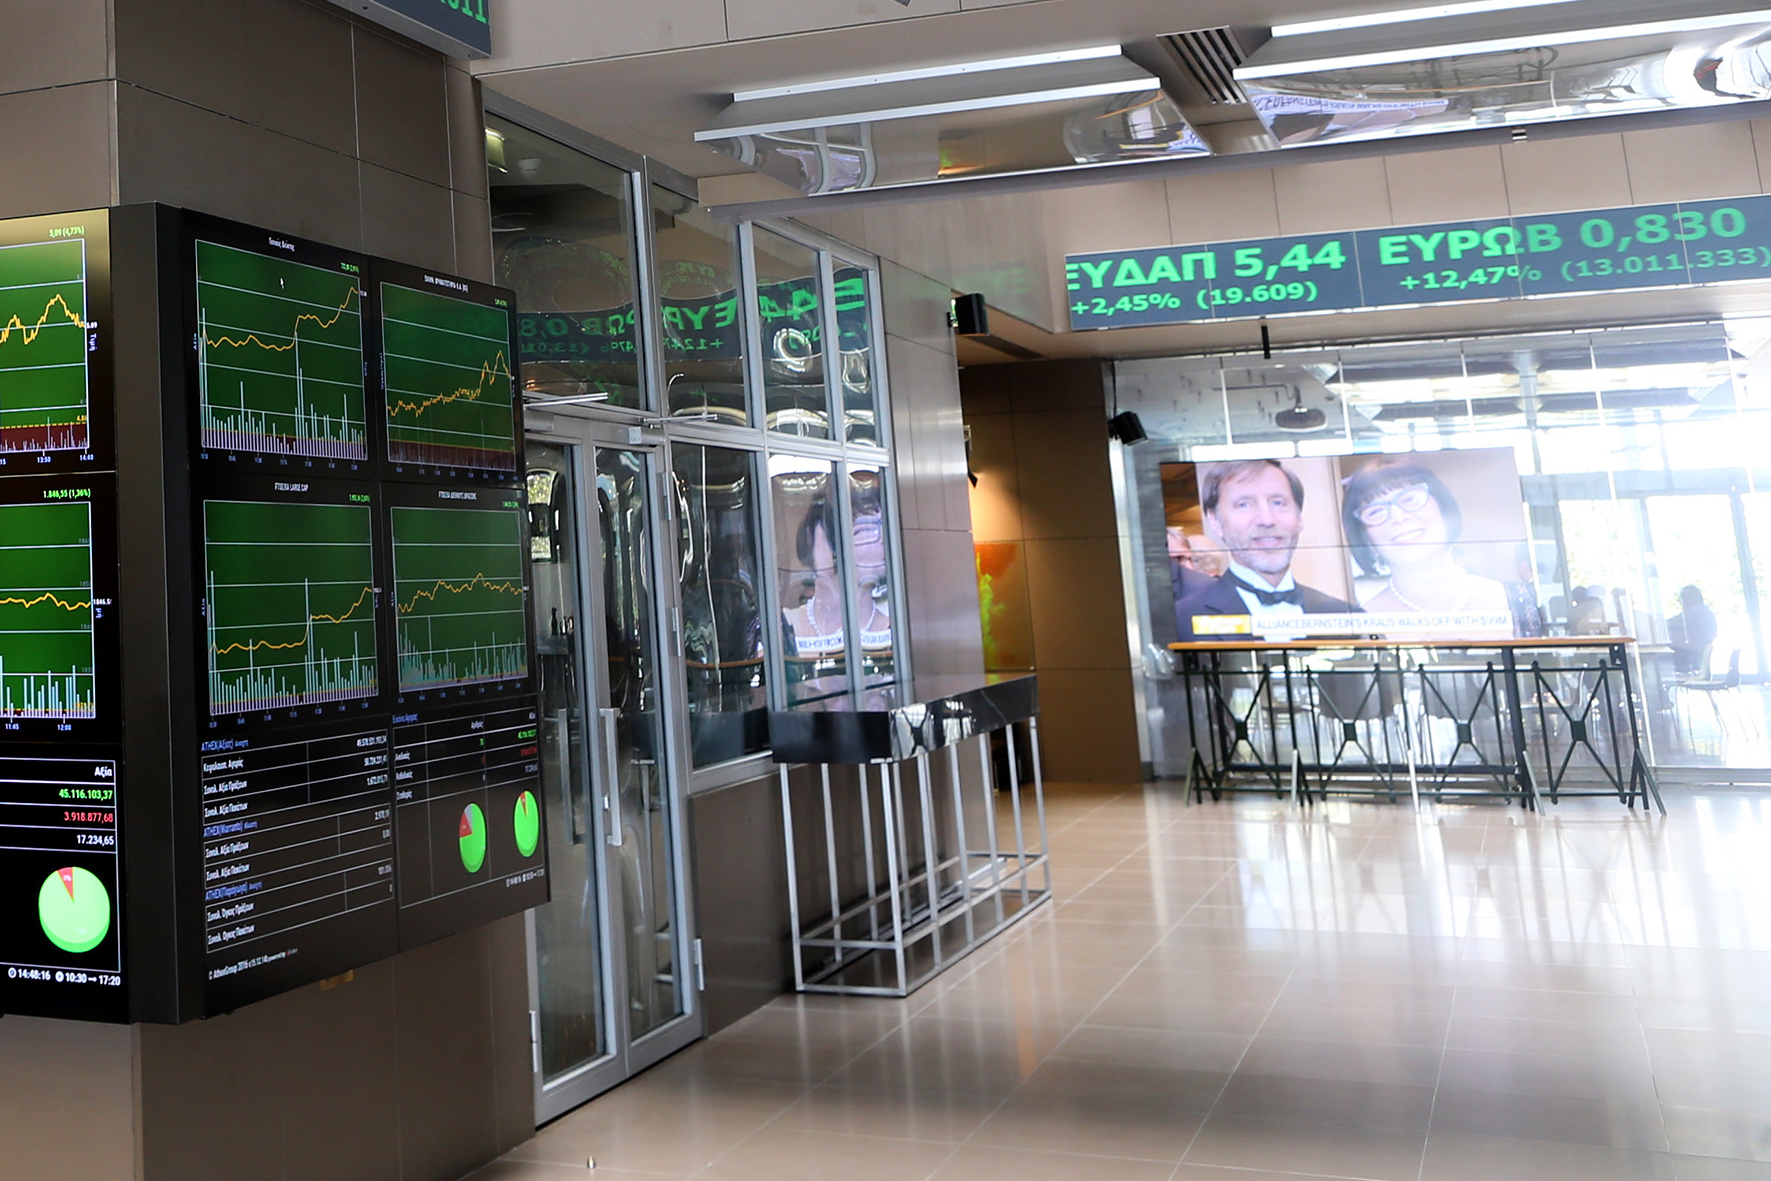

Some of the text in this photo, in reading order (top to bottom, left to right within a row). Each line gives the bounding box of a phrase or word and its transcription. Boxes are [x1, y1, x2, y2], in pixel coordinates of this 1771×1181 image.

[1580, 207, 1746, 252] 0,830
[1234, 241, 1347, 281] 5,44
[1400, 246, 1771, 290] +12,47% (13.011.333)
[1071, 281, 1318, 316] +2,45% (19.609)
[1398, 616, 1430, 628] WALKS
[1432, 616, 1451, 626] OFF
[1454, 616, 1478, 626] WITH
[94, 765, 113, 778] Αξία
[58, 788, 113, 801] 45.116.103,37
[64, 811, 114, 824] 3.918.877,68
[76, 834, 115, 847] 17.234,65
[17, 968, 121, 986] 14:48:16 10:30 17:20
